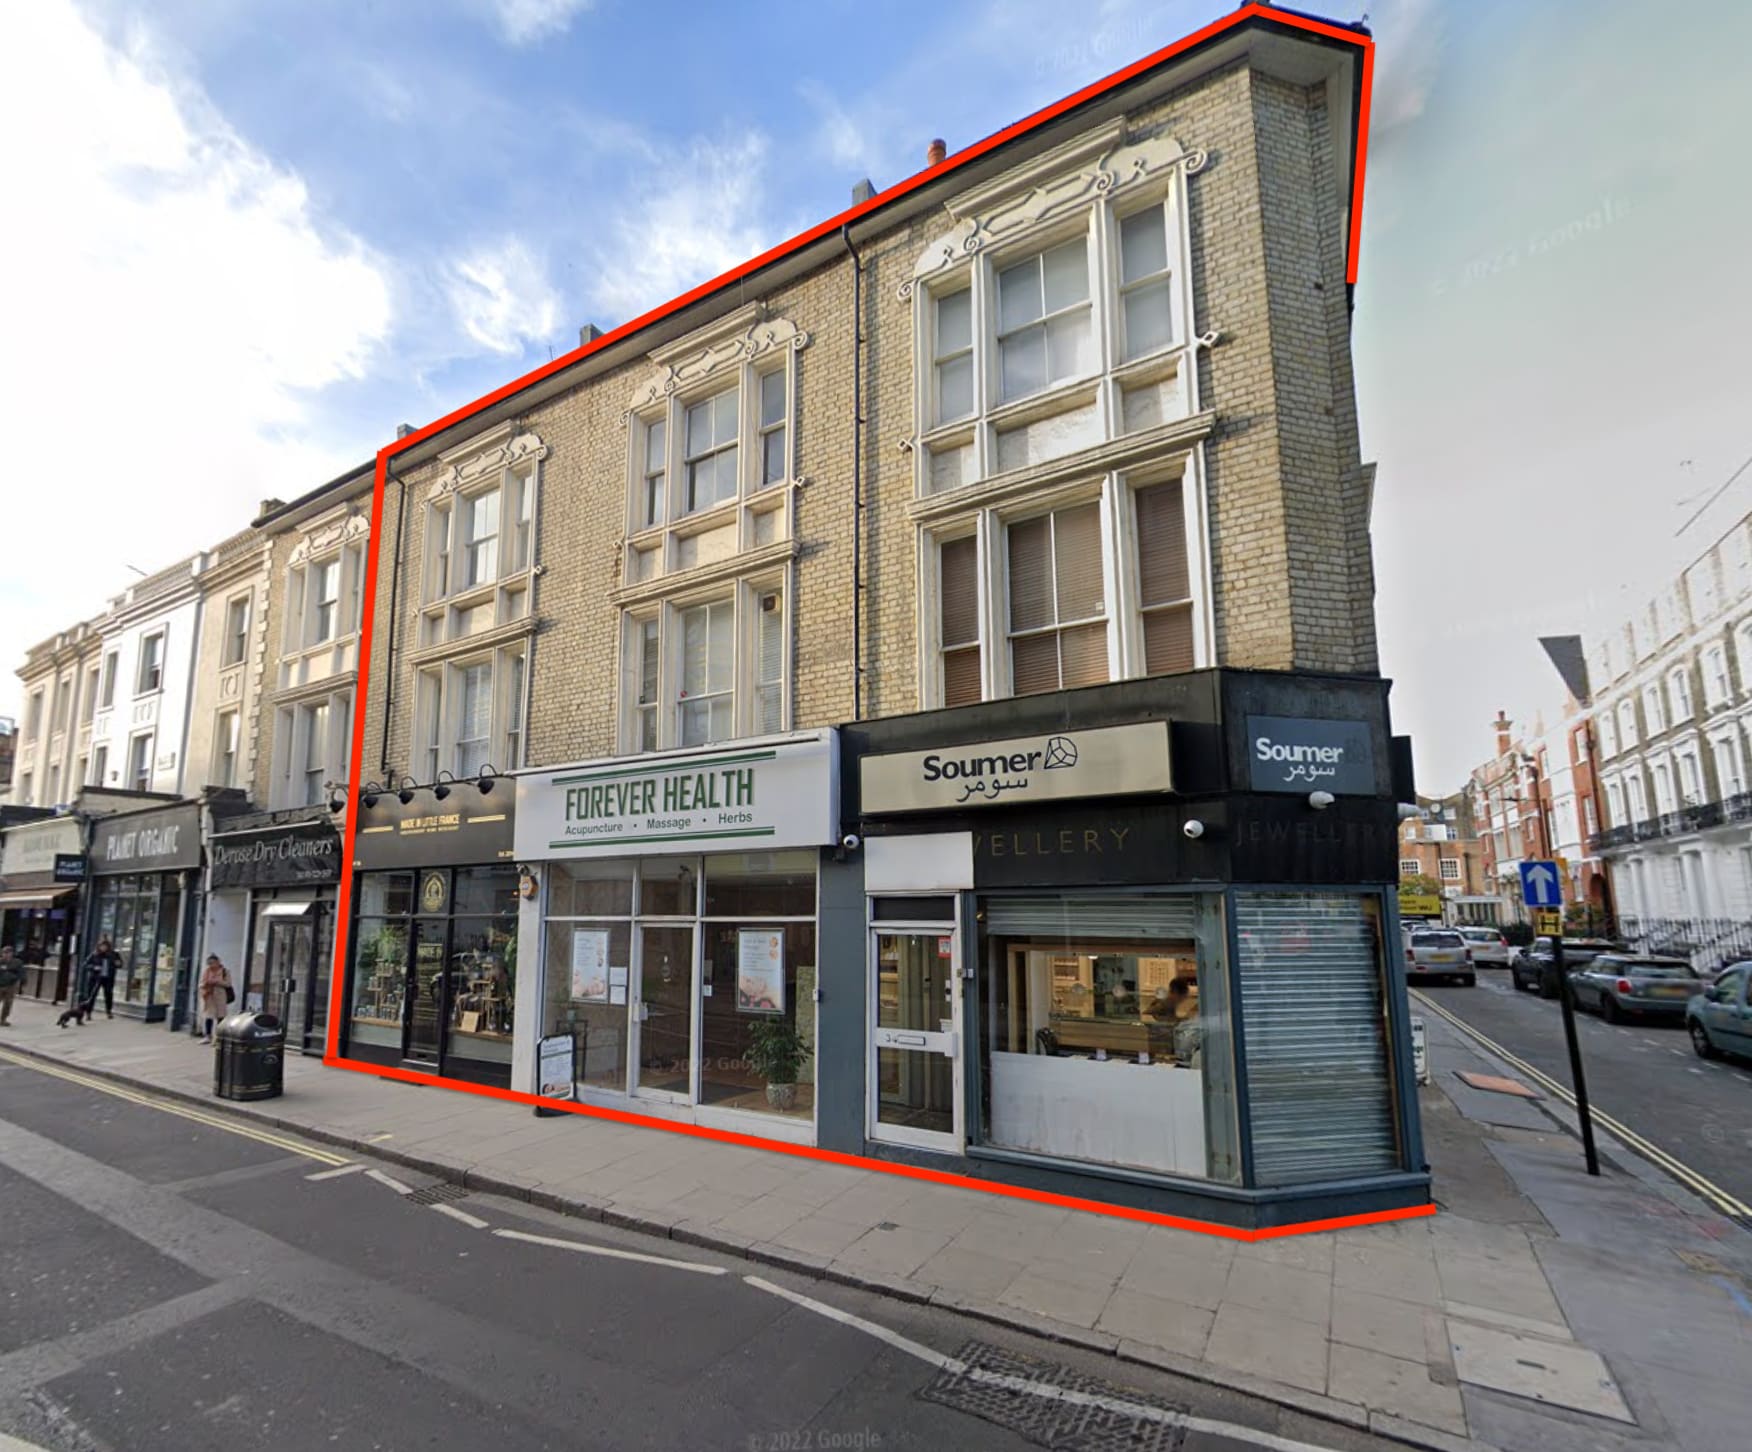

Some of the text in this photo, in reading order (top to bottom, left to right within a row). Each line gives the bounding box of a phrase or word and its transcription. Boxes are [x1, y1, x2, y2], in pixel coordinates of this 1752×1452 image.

[1255, 737, 1345, 763] Soumer
[923, 750, 1042, 782] Soumer
[1283, 763, 1336, 782] سومر
[565, 768, 754, 822] FOREVER HEALTH
[956, 776, 1029, 802] سومر
[565, 812, 753, 836] Acupuncture Massage Herbs
[253, 840, 277, 866] Dry
[278, 834, 333, 860] Cleaners
[1541, 914, 1559, 933] H
